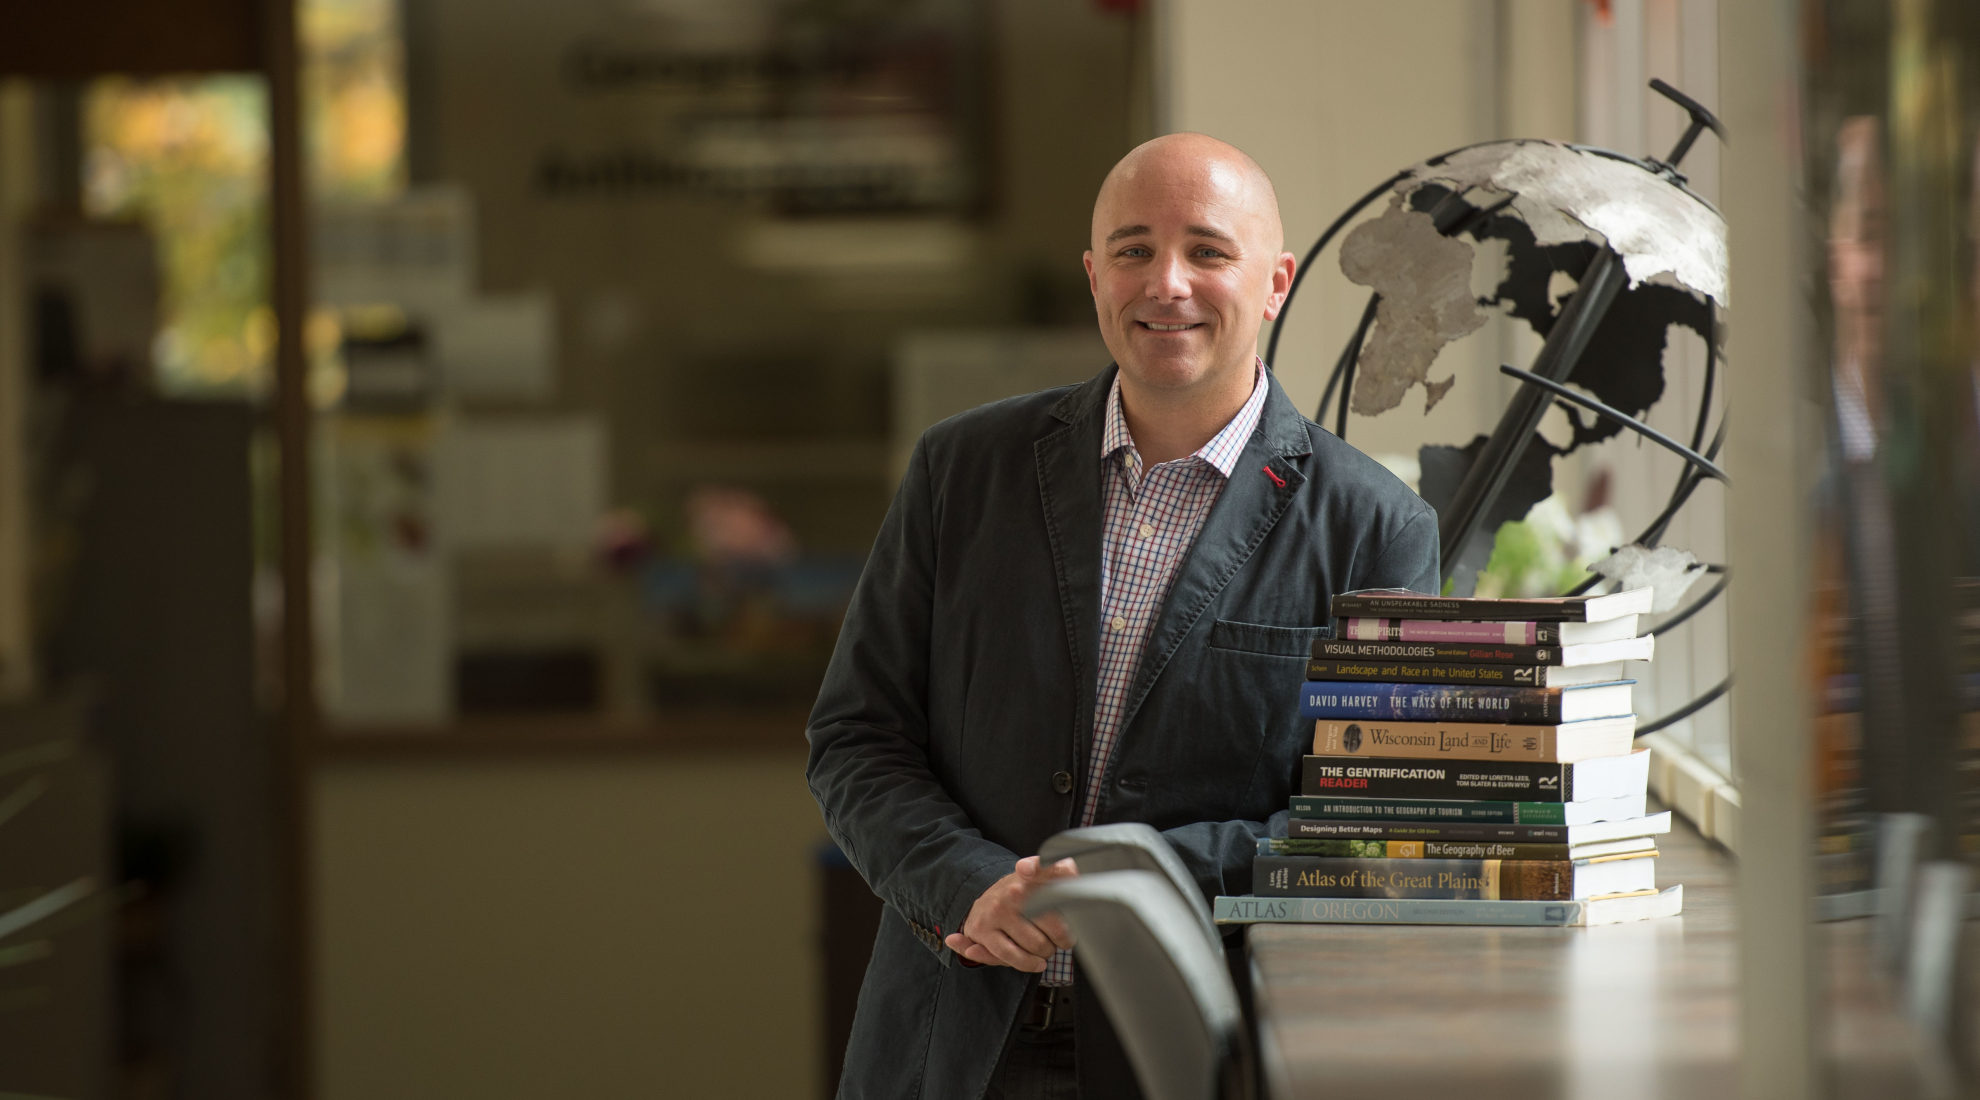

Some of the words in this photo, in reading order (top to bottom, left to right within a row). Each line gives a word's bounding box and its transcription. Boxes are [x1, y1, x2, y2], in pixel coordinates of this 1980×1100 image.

[1381, 600, 1427, 608] UNSPEAKABLE
[1427, 601, 1460, 609] SADNESS
[1324, 644, 1356, 655] VISUAL
[1358, 645, 1435, 657] METHODOLOGIES
[1336, 665, 1378, 677] Landscape
[1381, 665, 1397, 675] and
[1401, 666, 1420, 677] Race
[1422, 666, 1430, 677] in
[1432, 666, 1446, 677] the
[1449, 667, 1476, 679] United
[1478, 668, 1504, 679] States
[1309, 694, 1338, 707] DAVID
[1341, 695, 1378, 708] HARVEY
[1390, 696, 1406, 708] THE
[1411, 696, 1436, 709] WAYS
[1439, 697, 1451, 709] OF
[1456, 697, 1474, 709] THE
[1478, 697, 1510, 710] WORLD
[1370, 728, 1436, 746] Wisconsin
[1439, 730, 1469, 752] Land
[1490, 732, 1512, 753] Life
[1320, 766, 1344, 777] THE
[1346, 767, 1446, 780] GENTRIFICATION
[1459, 773, 1480, 781] EDITED
[1489, 774, 1514, 782] LORETTA
[1319, 777, 1368, 789] READER
[1470, 780, 1492, 788] SLATER
[1323, 804, 1332, 812] AN
[1333, 805, 1373, 814] INTRODUCTION
[1375, 806, 1382, 814] TO
[1384, 806, 1395, 815] THE
[1396, 806, 1428, 816] GEOGRAPHY
[1429, 807, 1436, 816] OF
[1438, 808, 1463, 816] TOURISM
[1300, 825, 1338, 834] Designing
[1362, 826, 1383, 834] Maps
[1427, 843, 1442, 855] The
[1442, 843, 1485, 858] Geography
[1486, 844, 1496, 856] of
[1496, 844, 1515, 856] Beer
[1296, 869, 1336, 888] Atlas
[1340, 869, 1359, 888] of
[1360, 870, 1385, 888] the
[1389, 871, 1433, 889] Great
[1438, 871, 1488, 890] Plains
[1229, 901, 1288, 919] ATLAS
[1312, 902, 1400, 920] OREGON
